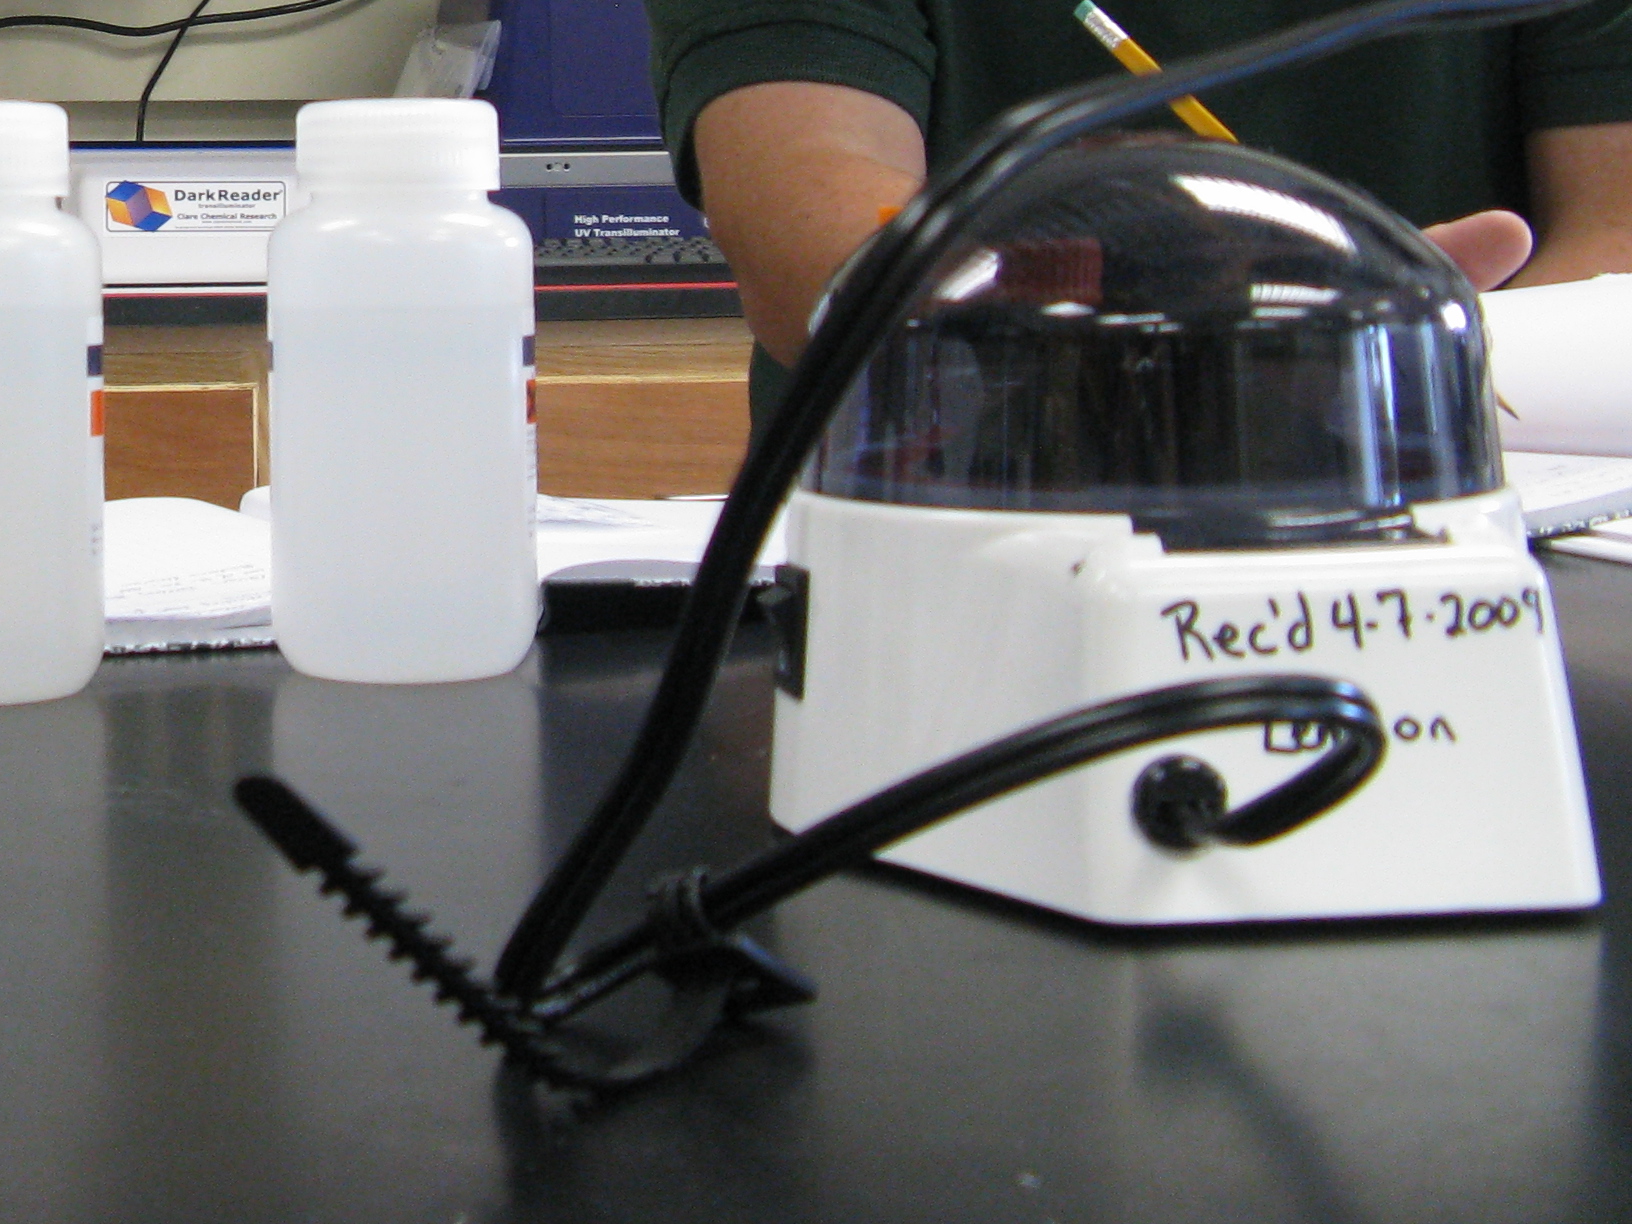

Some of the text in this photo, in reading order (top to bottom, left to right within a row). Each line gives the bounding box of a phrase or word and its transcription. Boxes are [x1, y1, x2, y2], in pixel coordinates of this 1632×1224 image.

[574, 214, 669, 225] High Performance
[574, 228, 680, 237] UV Transilluminator
[1161, 591, 1314, 662] Rec'd
